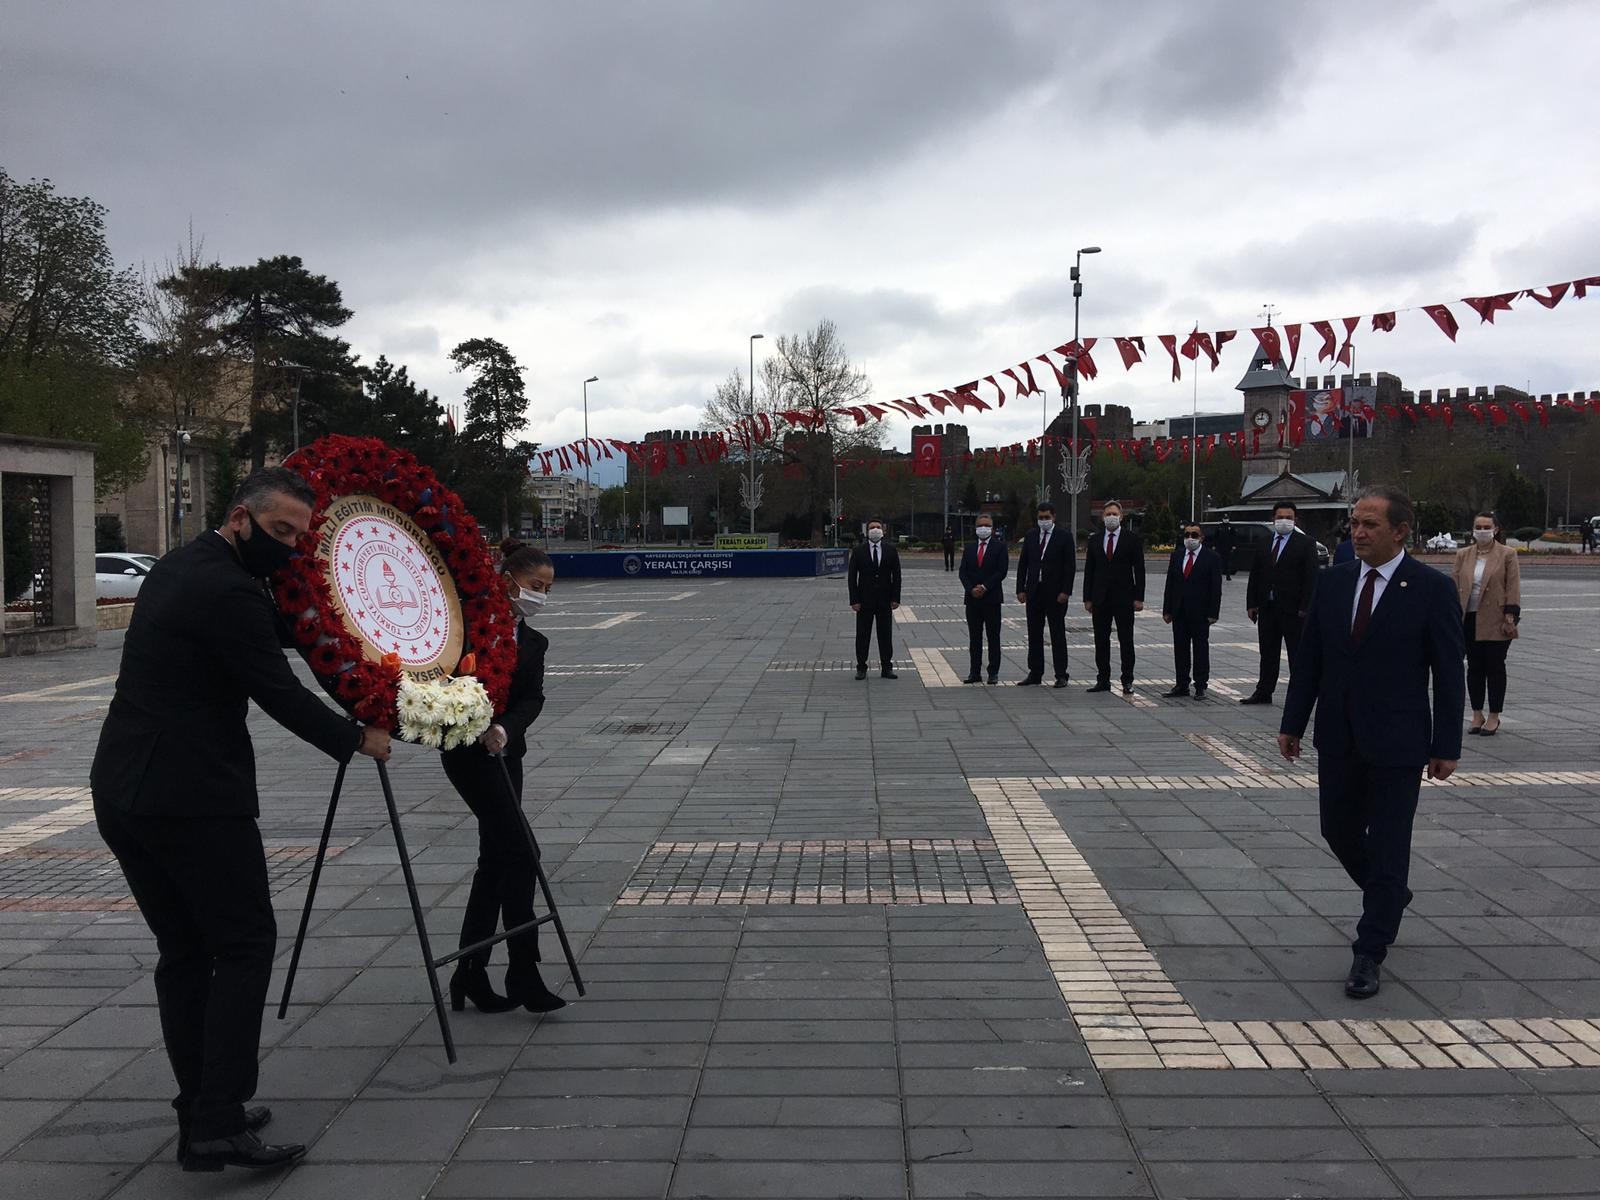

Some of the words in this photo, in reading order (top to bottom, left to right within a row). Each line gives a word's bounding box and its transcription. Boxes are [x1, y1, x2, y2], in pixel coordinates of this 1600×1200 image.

[335, 499, 374, 521] EĞİTİM
[644, 560, 687, 569] YERALTI
[690, 560, 732, 571] ÇARŞISI
